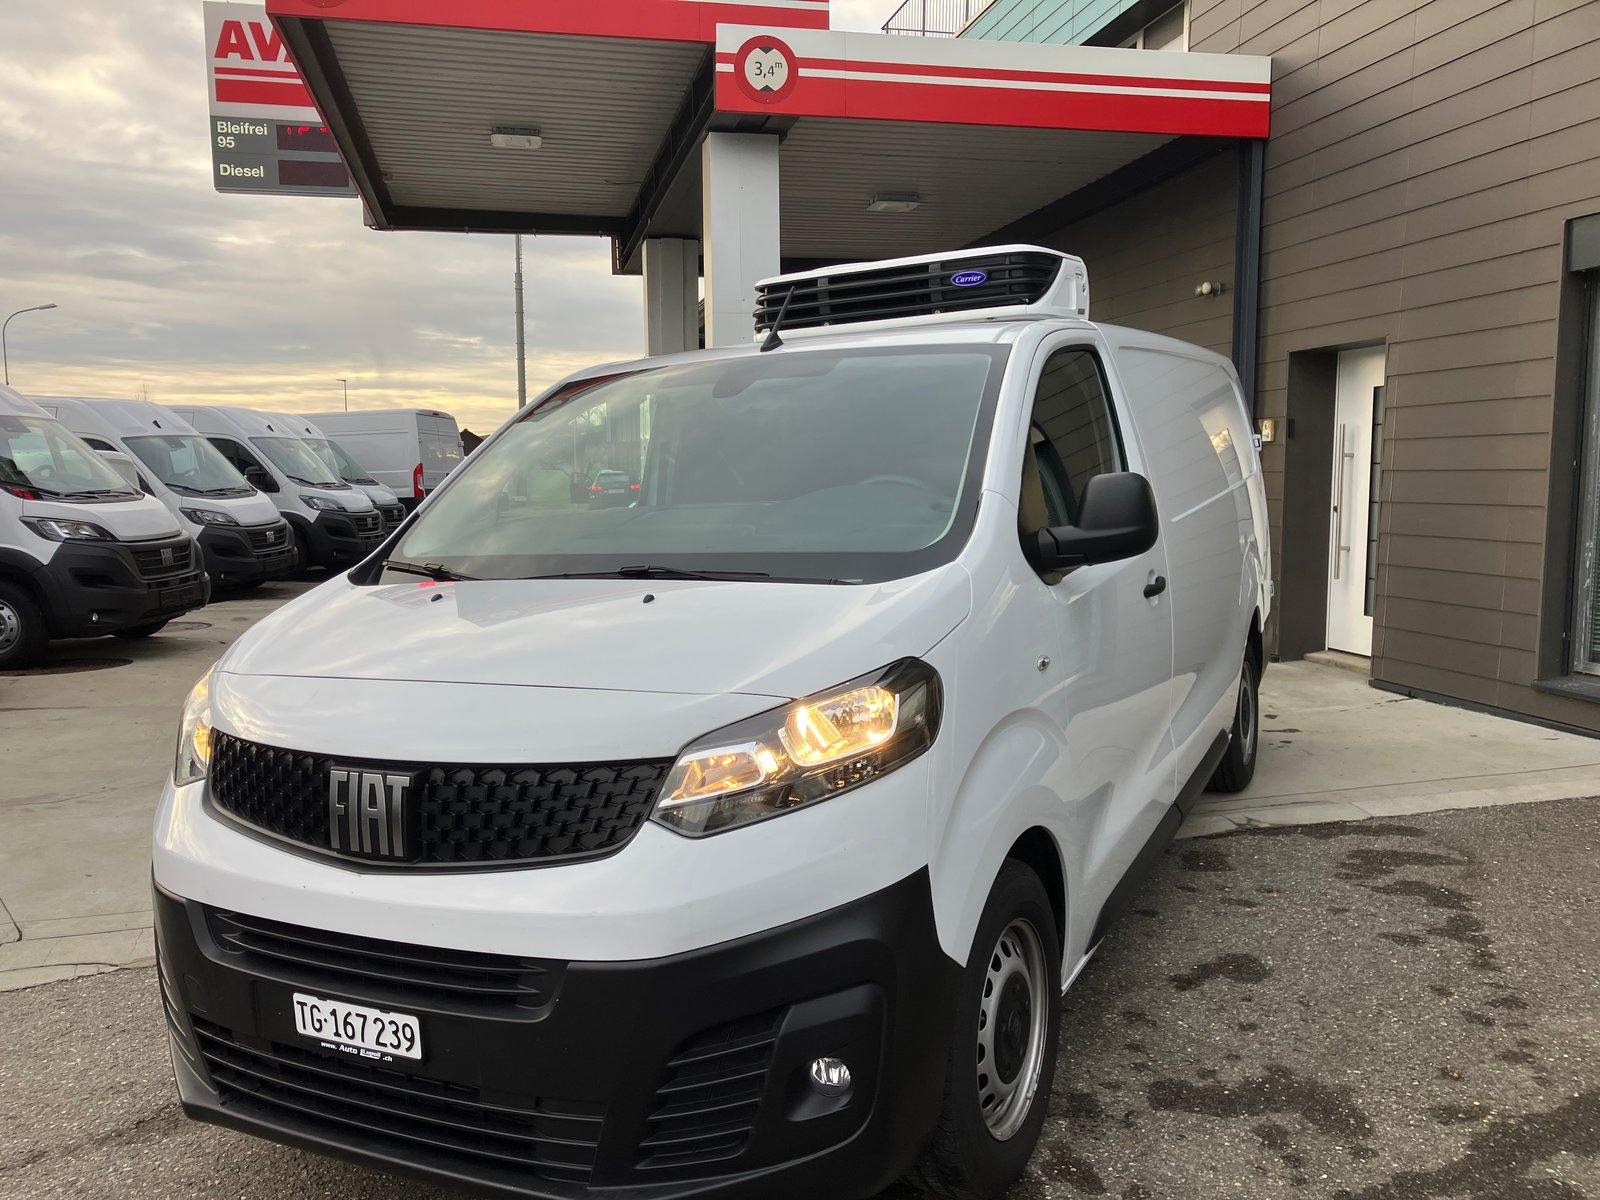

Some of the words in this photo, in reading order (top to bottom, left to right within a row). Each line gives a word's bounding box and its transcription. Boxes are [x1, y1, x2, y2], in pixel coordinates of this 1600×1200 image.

[214, 20, 293, 63] AV
[216, 121, 268, 135] Bleifrei
[217, 136, 236, 148] 95
[219, 163, 264, 178] Diesel
[955, 275, 982, 283] Carrier
[329, 770, 410, 857] FIAT
[339, 1044, 358, 1055] Auto
